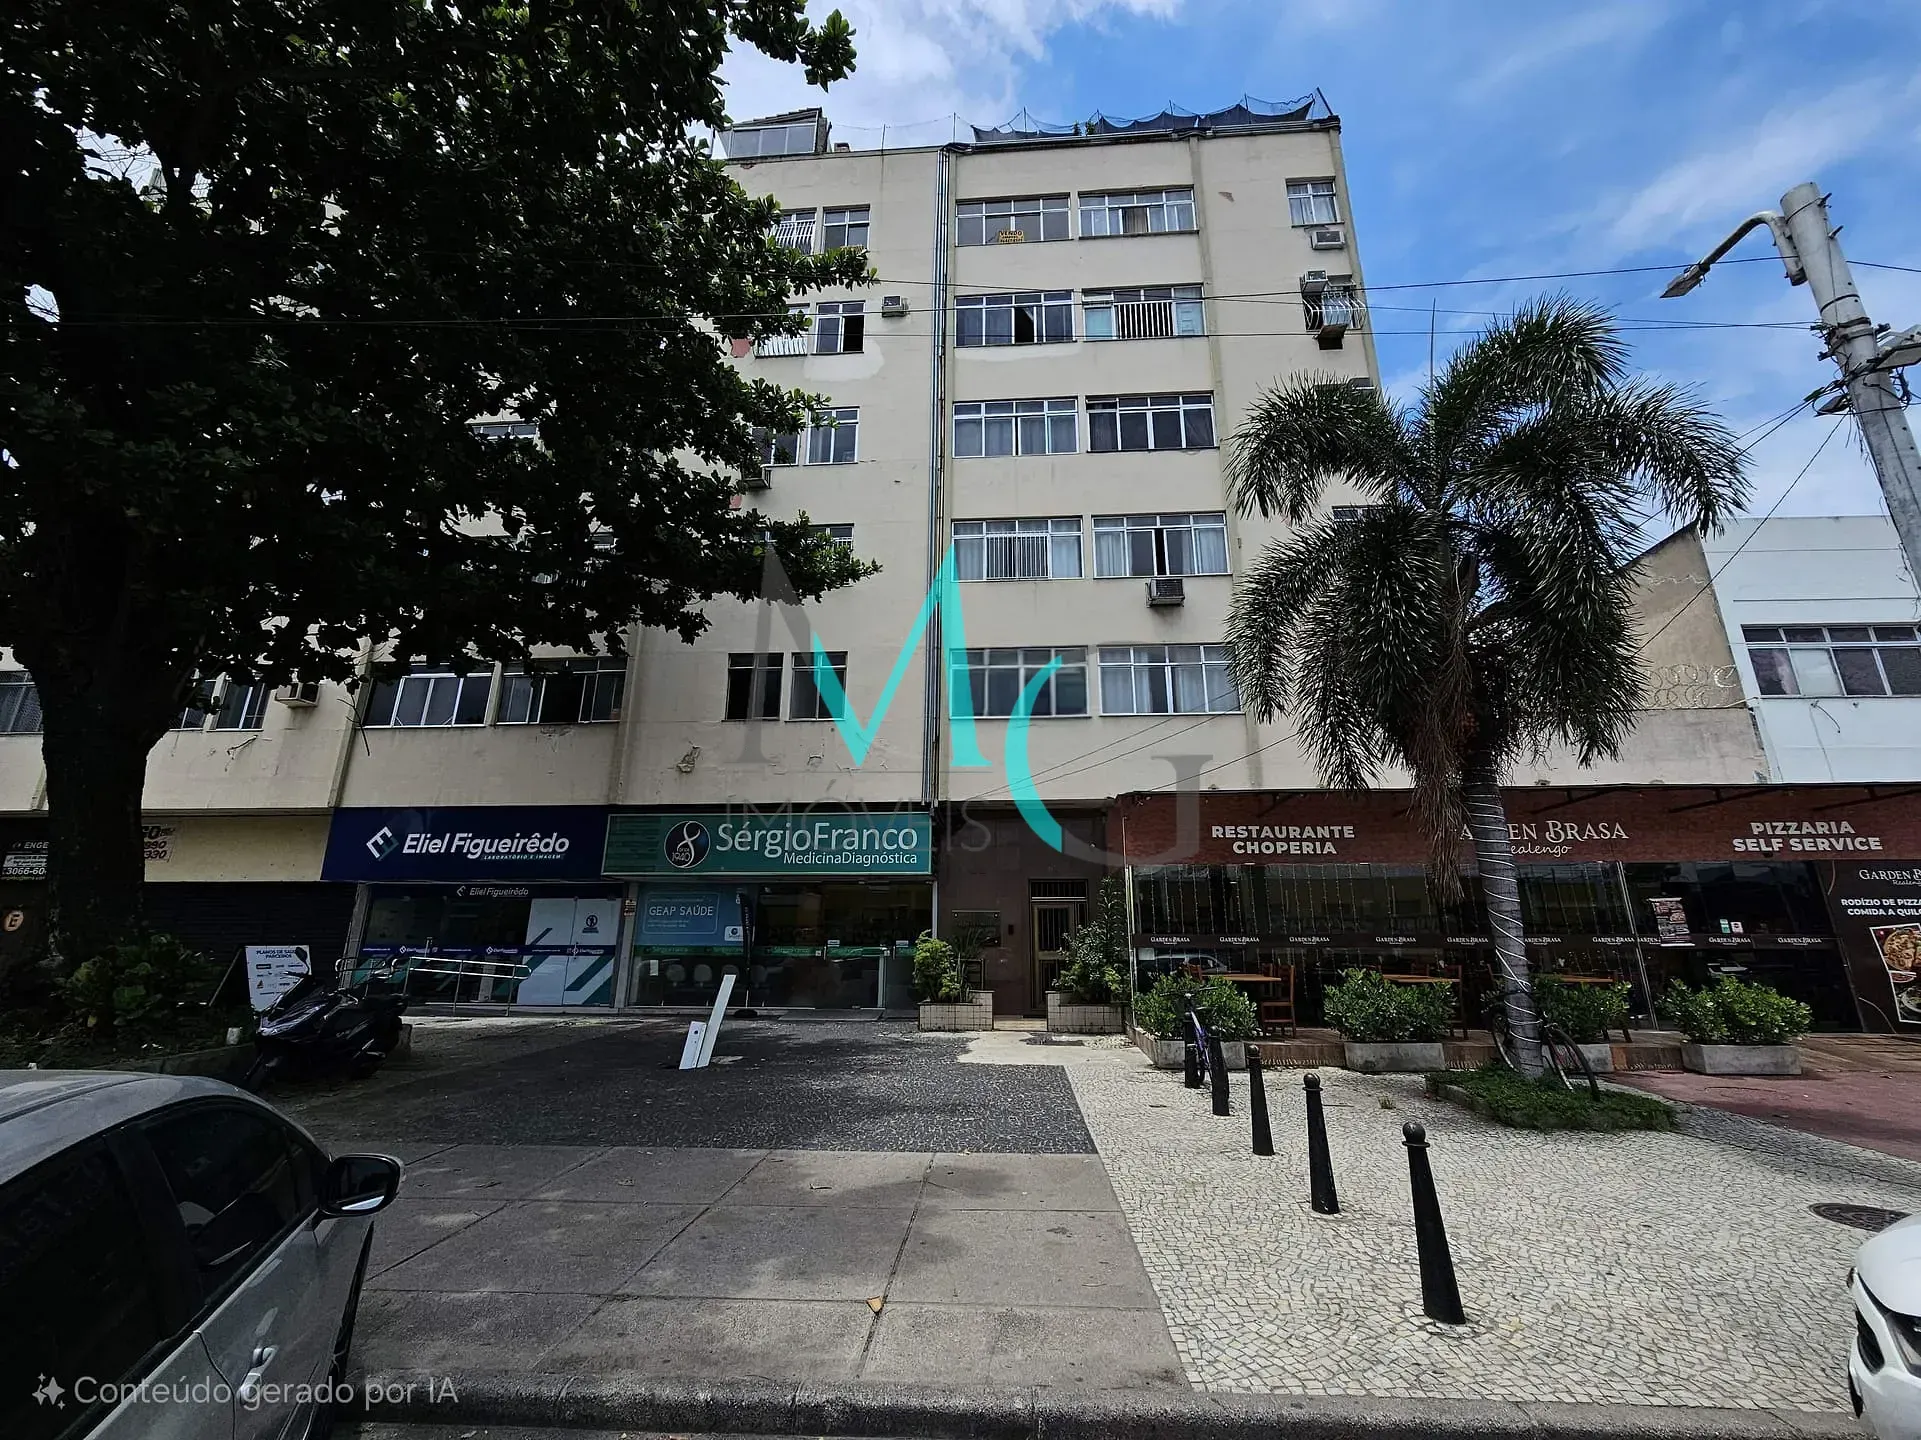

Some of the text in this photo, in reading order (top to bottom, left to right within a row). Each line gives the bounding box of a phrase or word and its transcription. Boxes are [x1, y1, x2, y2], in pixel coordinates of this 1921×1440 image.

[1212, 825, 1355, 839] RESTAURANTE
[1546, 821, 1629, 843] BRASA
[1750, 821, 1855, 835] PIZZARIA
[402, 832, 570, 859] Eliel Figueirêdo
[1233, 842, 1337, 854] CHOPERIA
[1511, 843, 1572, 857] ealengo
[1732, 837, 1883, 852] SELF SERVICE
[6, 867, 47, 875] 3066-60
[1859, 869, 1911, 881] GARDEN
[469, 888, 485, 896] Eliel
[1841, 897, 1880, 906] RODÍZIO
[649, 906, 676, 916] GEAP
[679, 904, 714, 916] SAÚDE
